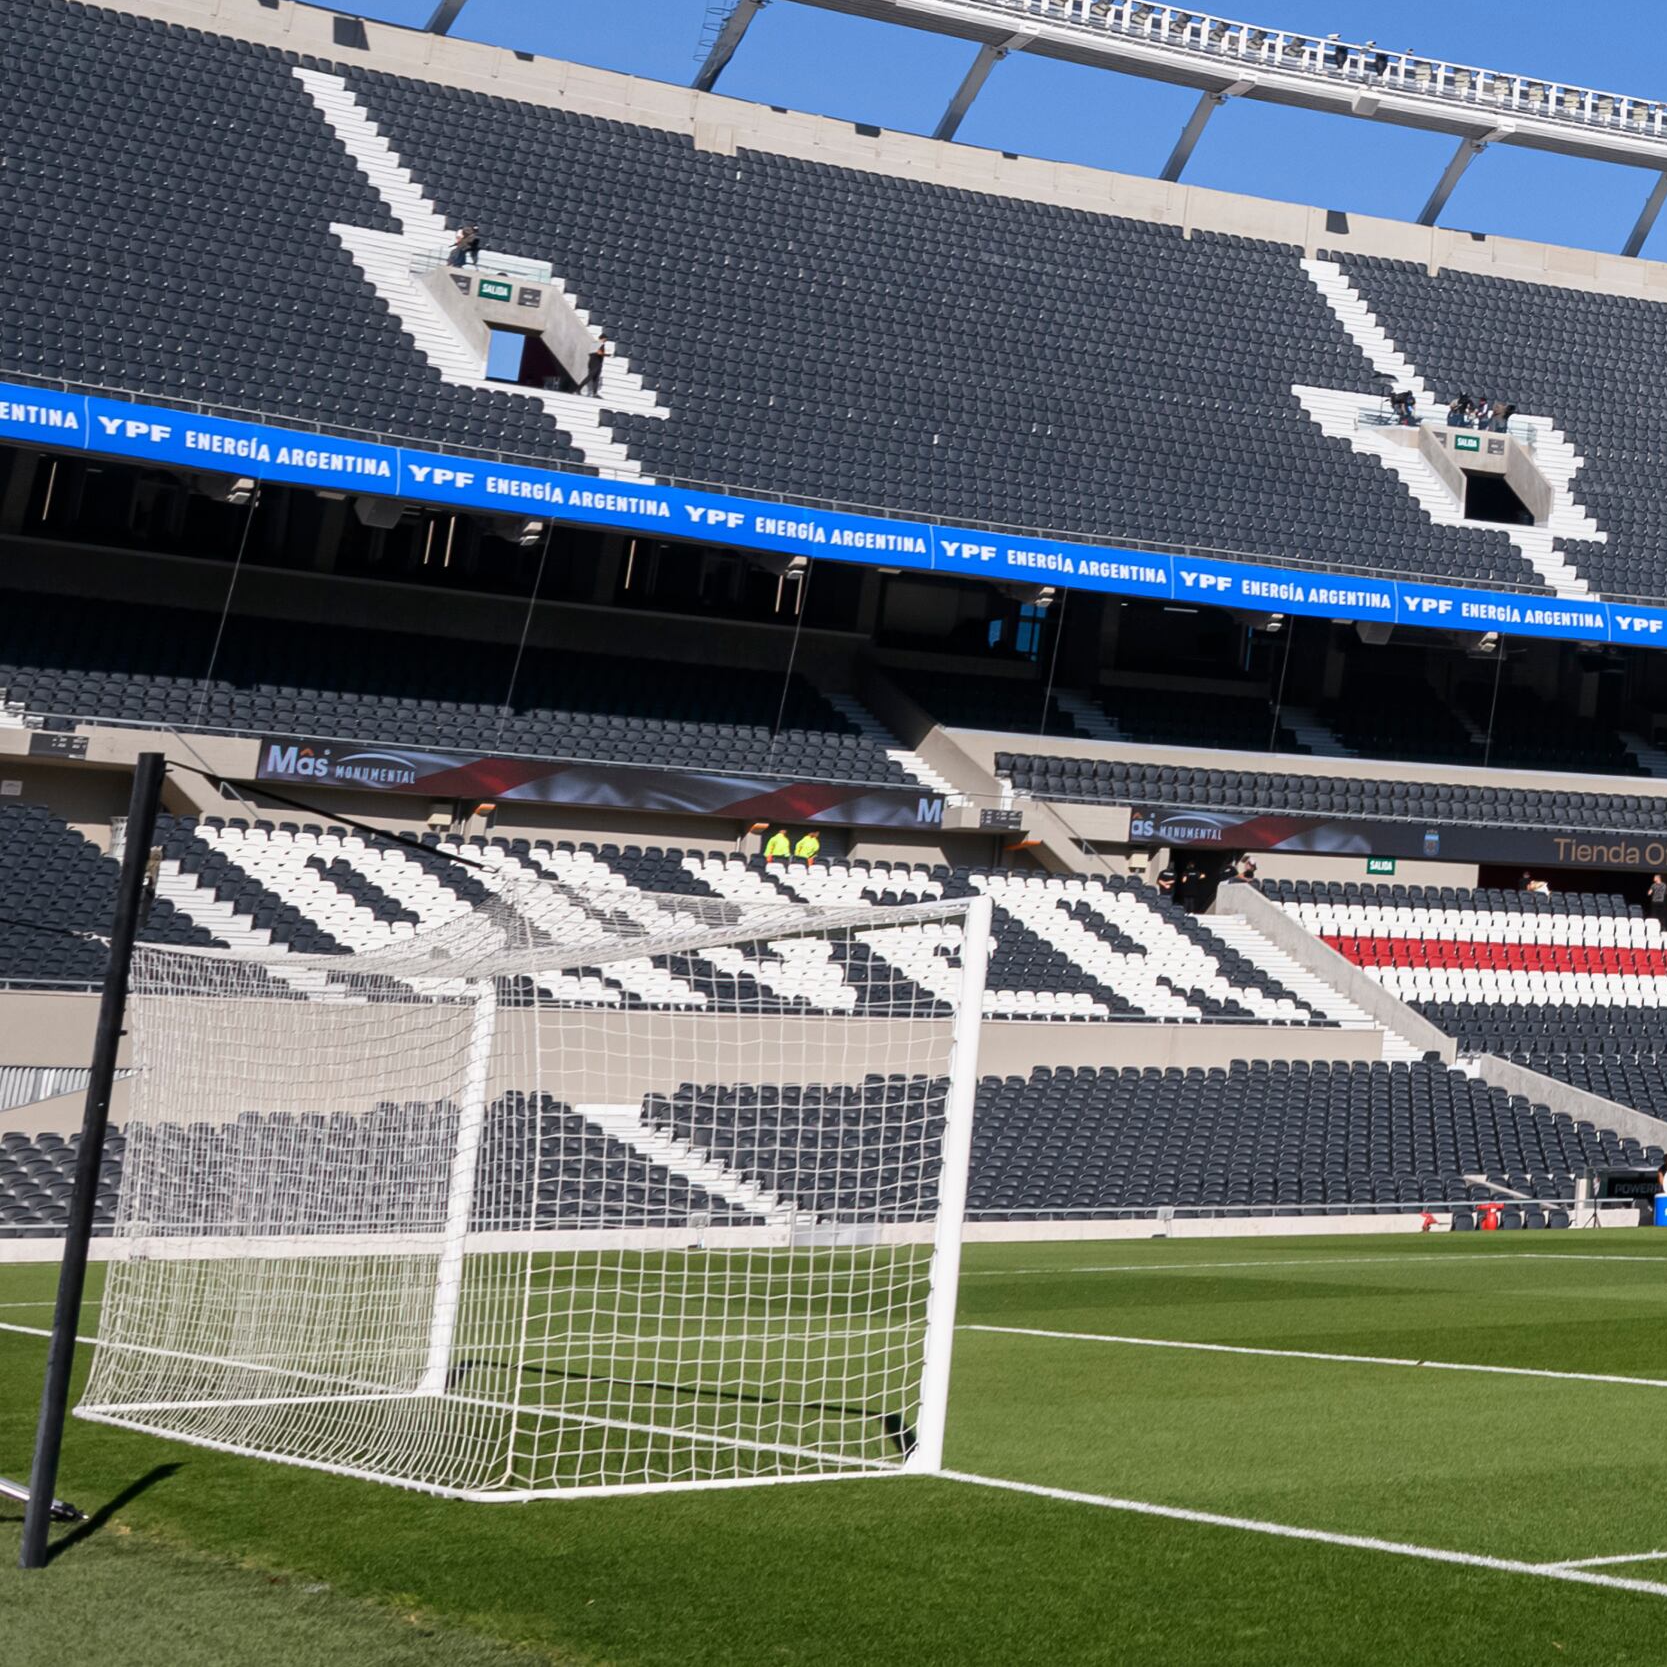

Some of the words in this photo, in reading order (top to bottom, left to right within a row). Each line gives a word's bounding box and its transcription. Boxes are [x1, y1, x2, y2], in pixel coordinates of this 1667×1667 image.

[98, 416, 172, 442] YPF
[185, 430, 272, 463] ENERGÍA
[275, 447, 392, 477] ARGENTINA
[408, 464, 476, 488] YPF
[486, 476, 565, 504] ENERGÍA
[568, 490, 671, 518] ARGENTINA
[684, 505, 746, 528] YPF
[755, 516, 827, 543] ENERGÍA
[830, 529, 928, 554] ARGENTINA
[940, 540, 998, 561] YPF
[1007, 549, 1074, 574] ENERGÍA
[1078, 560, 1168, 584] ARGENTINA
[1179, 571, 1234, 591] YPF
[1241, 579, 1306, 602] ENERGÍA
[1308, 588, 1392, 609] ARGENTINA
[1403, 596, 1454, 614] YPF
[1461, 602, 1522, 623] ENERGÍA
[1524, 609, 1605, 628] ARGENTINA
[1615, 615, 1664, 633] YPF
[335, 765, 416, 785] MONUMENTAL
[1160, 825, 1223, 841] MONUMENTAL
[1369, 860, 1393, 871] SALIDA
[1553, 837, 1640, 865] Tienda
